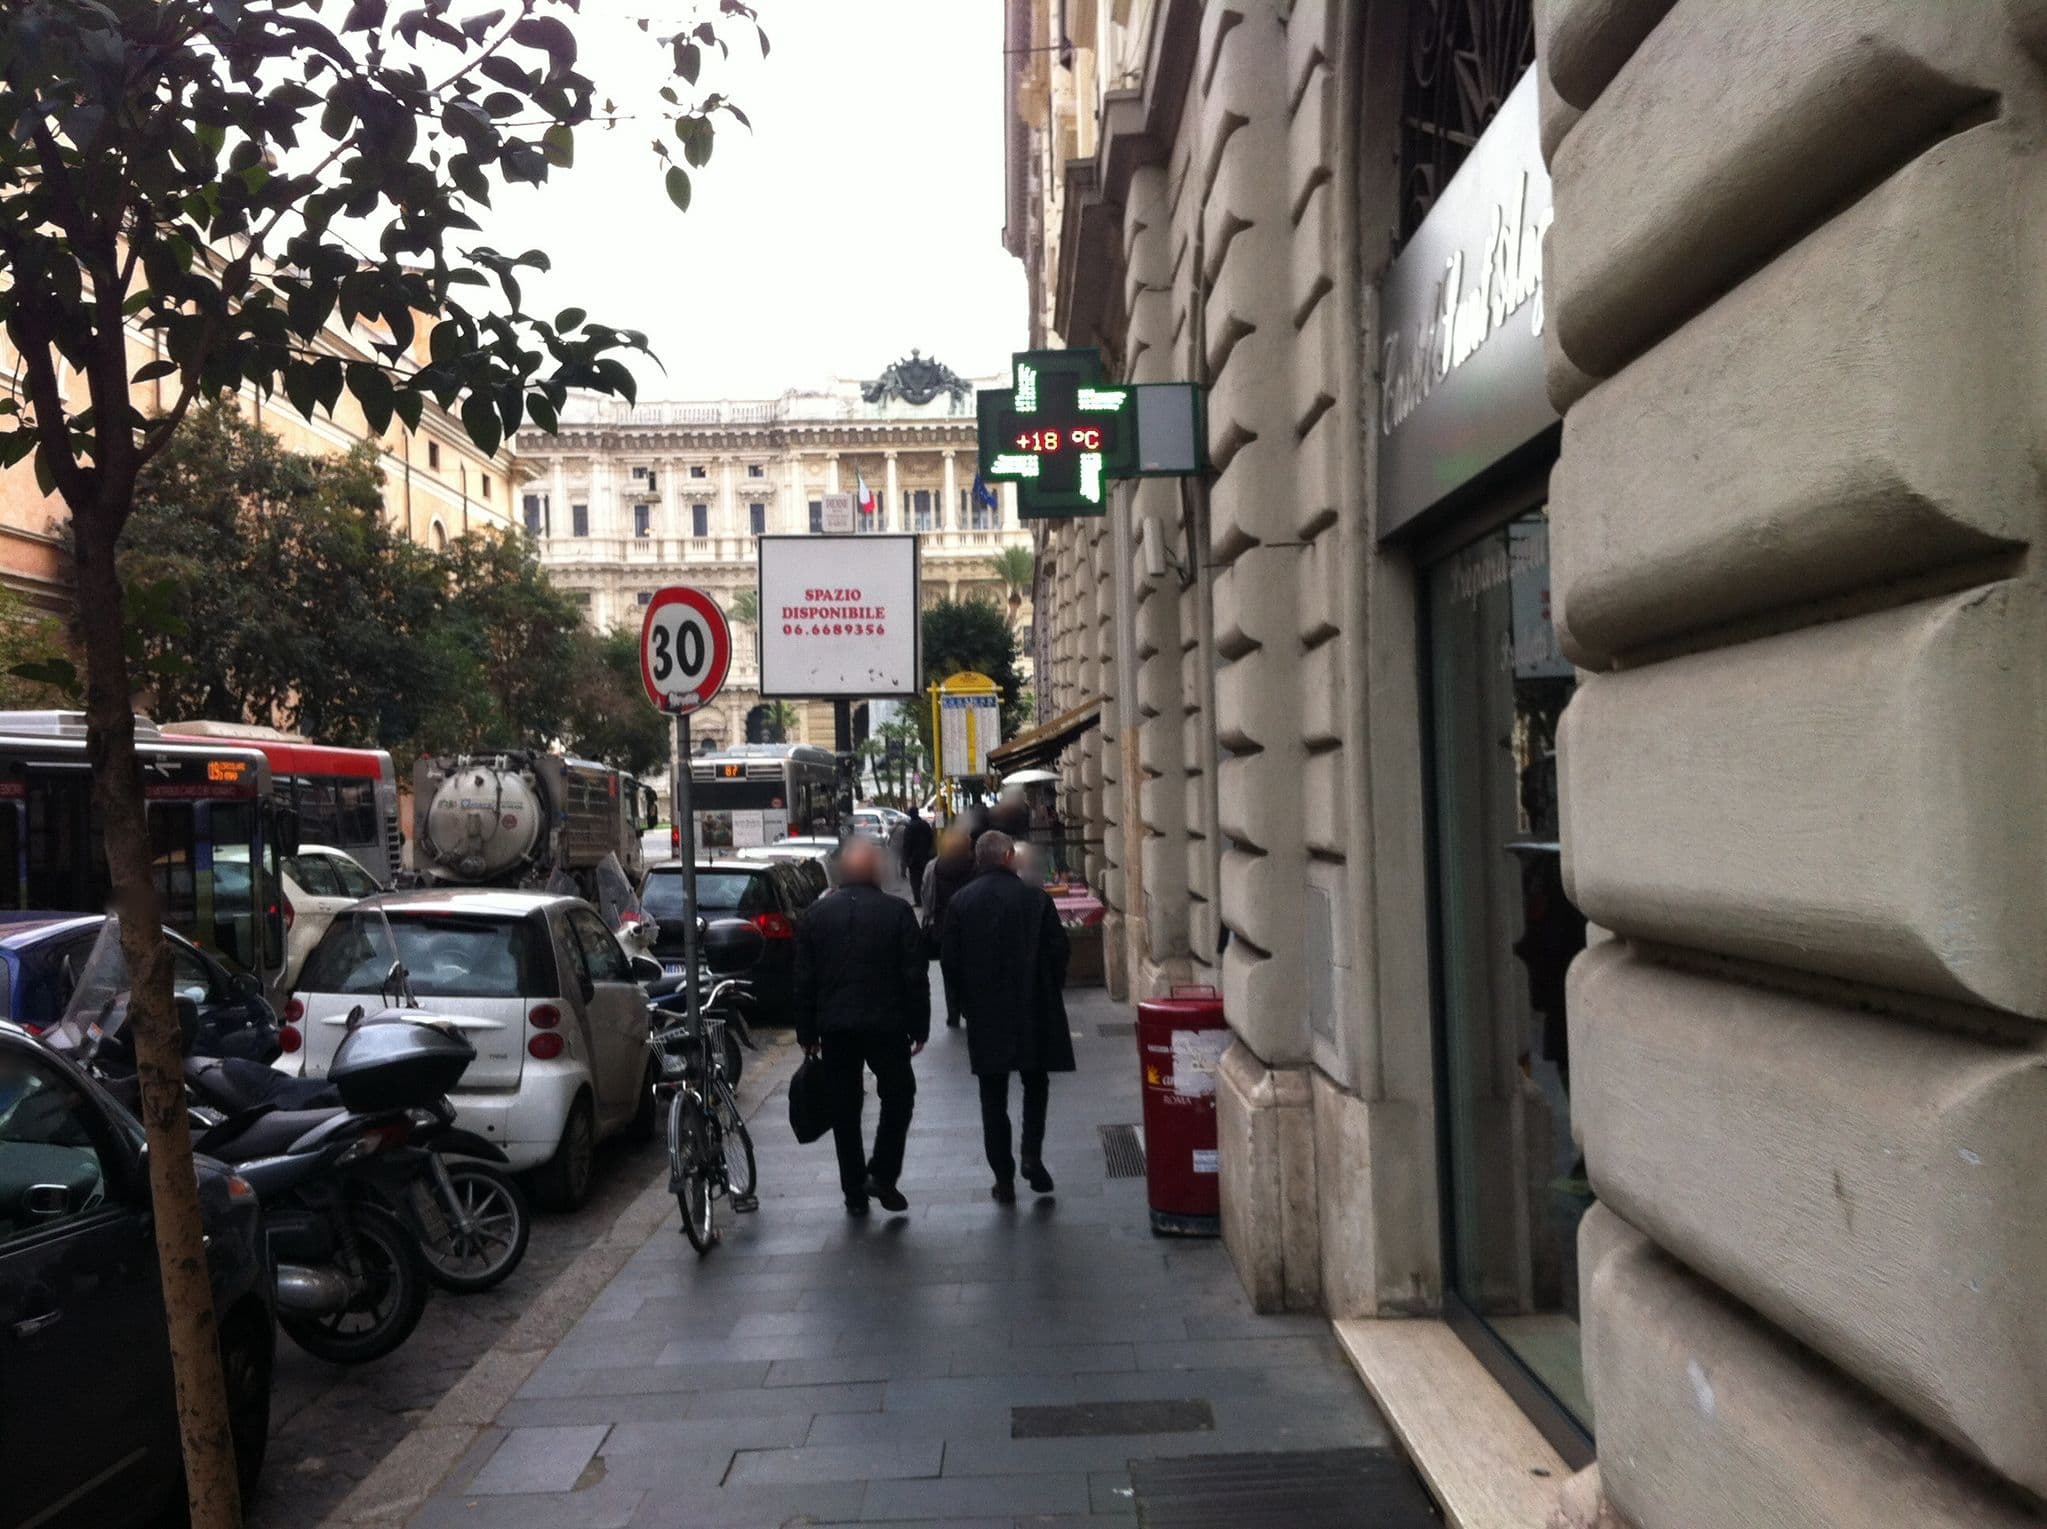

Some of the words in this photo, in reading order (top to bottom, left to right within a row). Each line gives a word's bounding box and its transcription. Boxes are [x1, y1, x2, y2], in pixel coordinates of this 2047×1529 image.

[1016, 432, 1058, 450] +18
[805, 589, 861, 601] SPAZIO
[782, 607, 885, 619] DISPONIBILE
[783, 624, 885, 635] 06.6689356
[653, 620, 705, 681] 30
